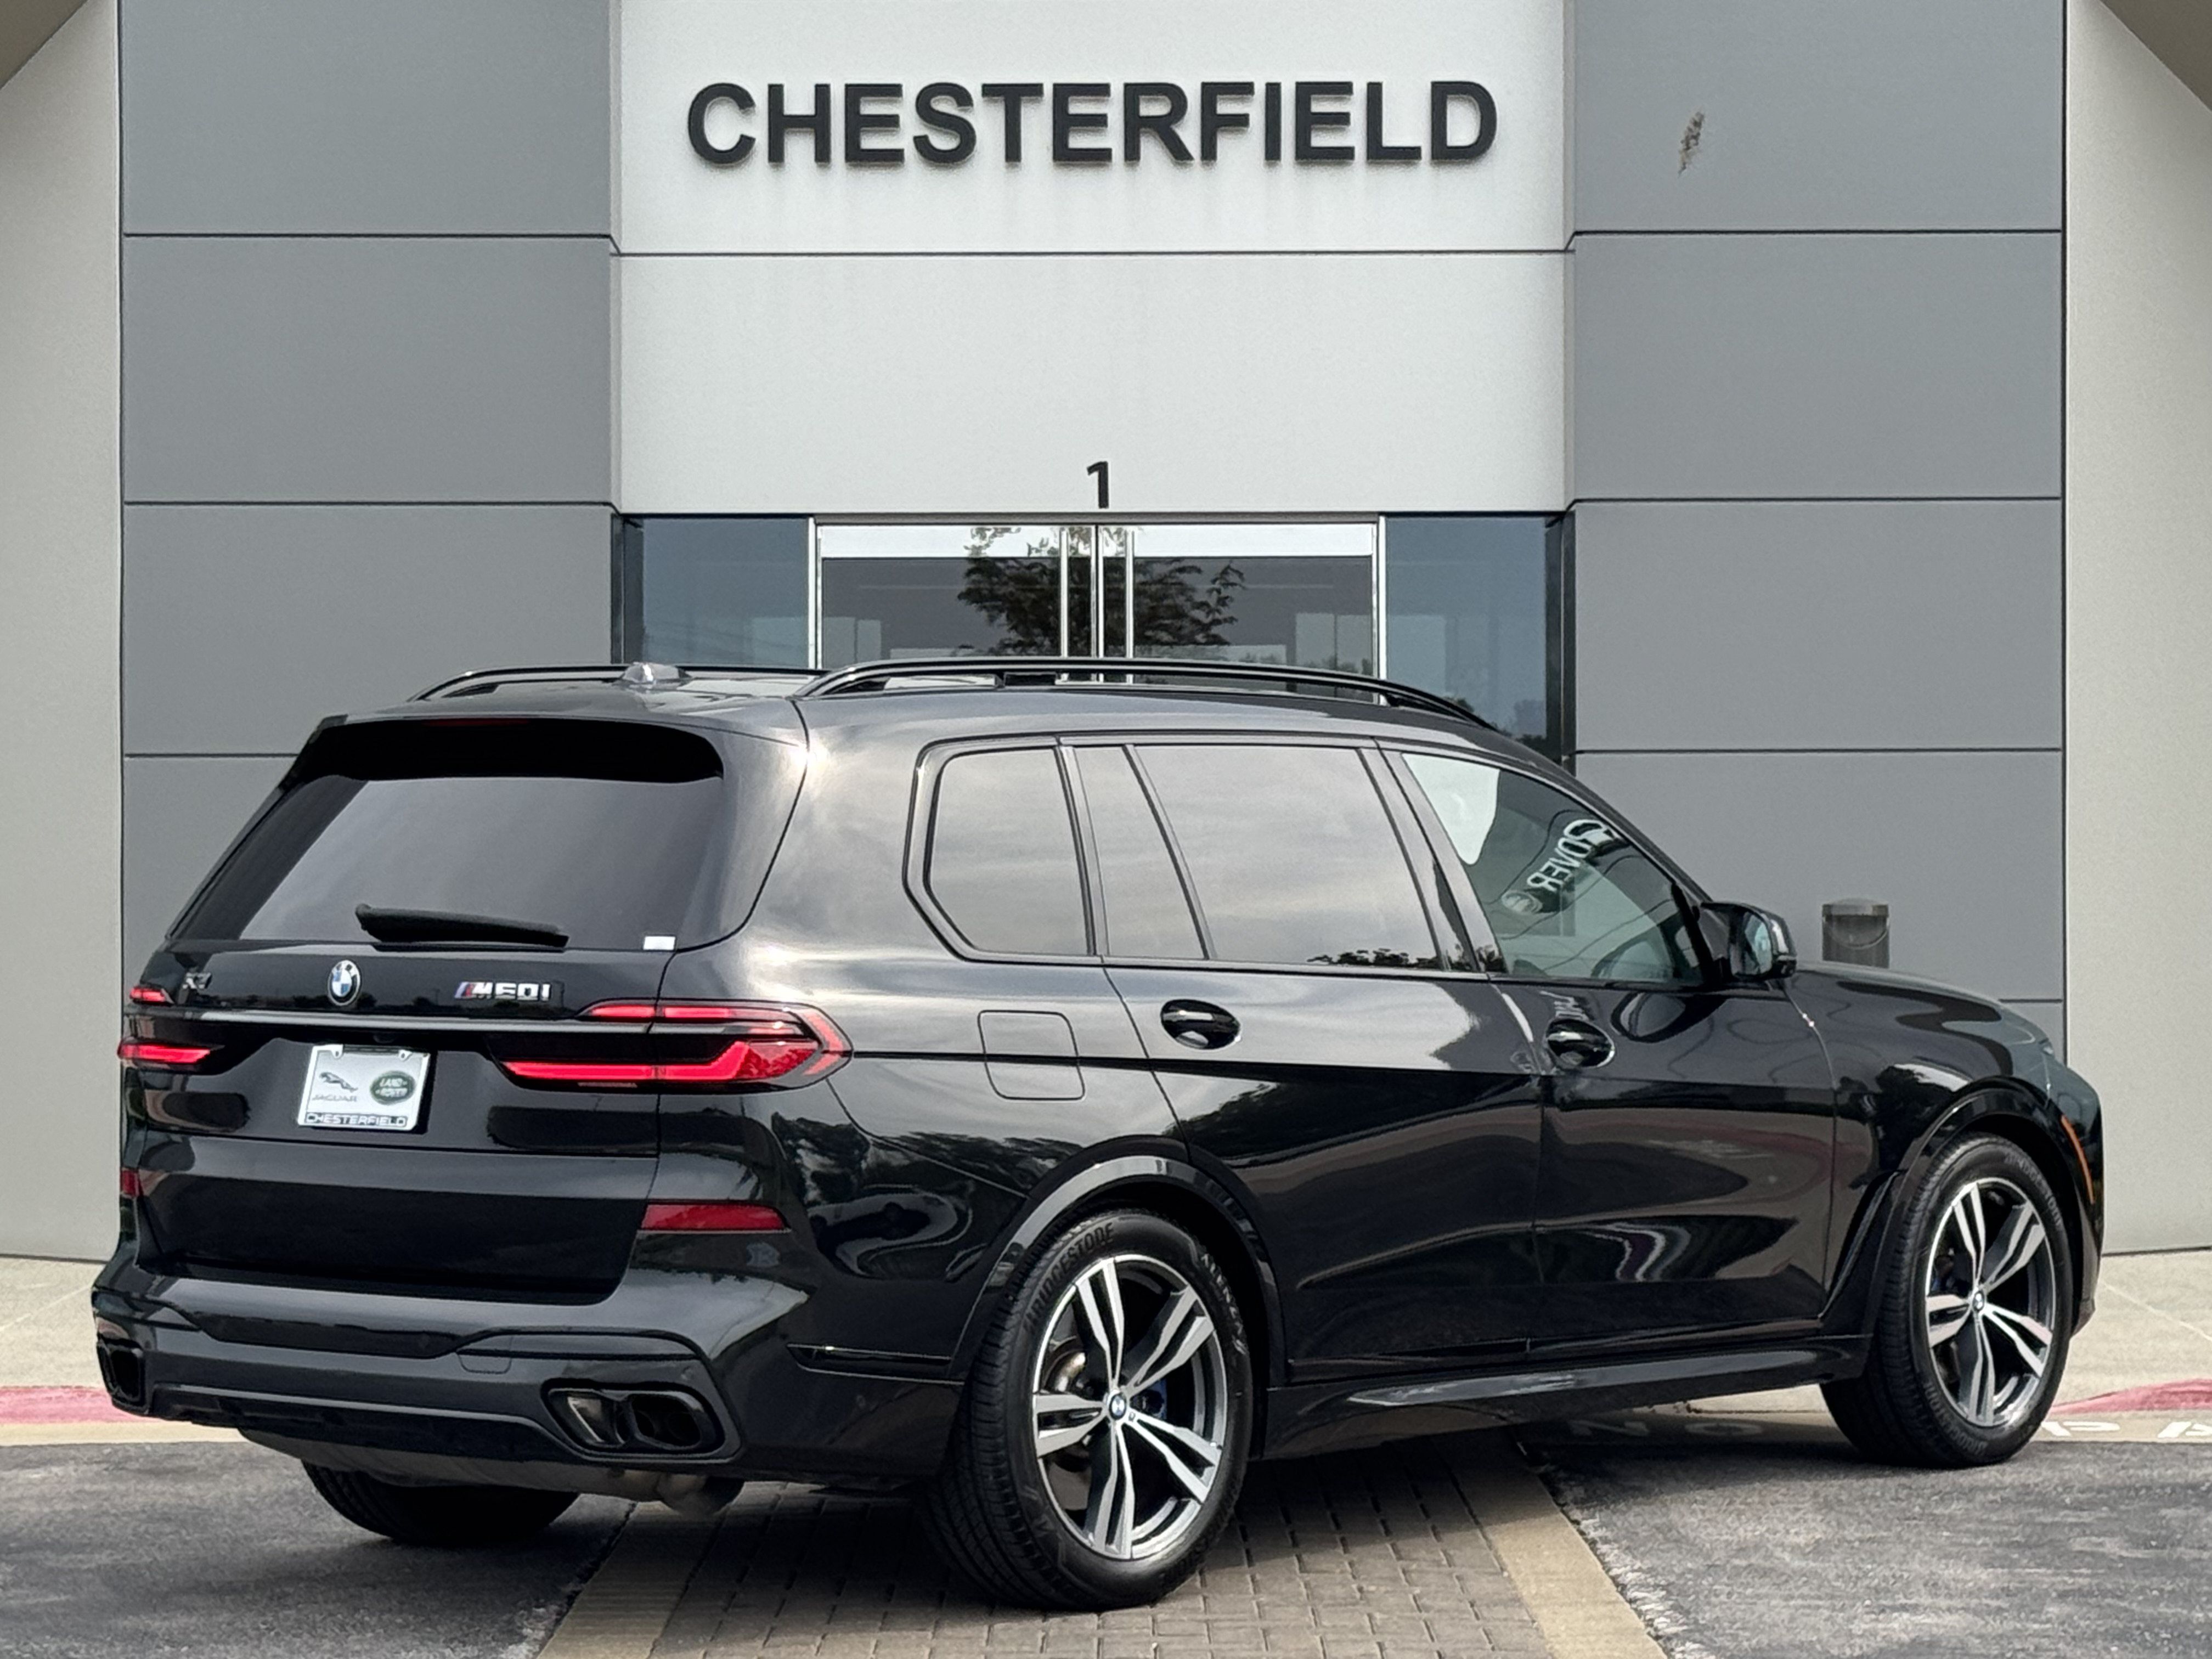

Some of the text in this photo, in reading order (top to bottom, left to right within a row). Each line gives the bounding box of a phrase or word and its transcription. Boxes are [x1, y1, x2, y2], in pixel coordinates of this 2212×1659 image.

[687, 81, 1498, 165] CHESTERFIELD
[1087, 461, 1109, 509] 1
[312, 1094, 358, 1102] JAGUAR
[306, 1113, 407, 1127] CHESTERFIELD
